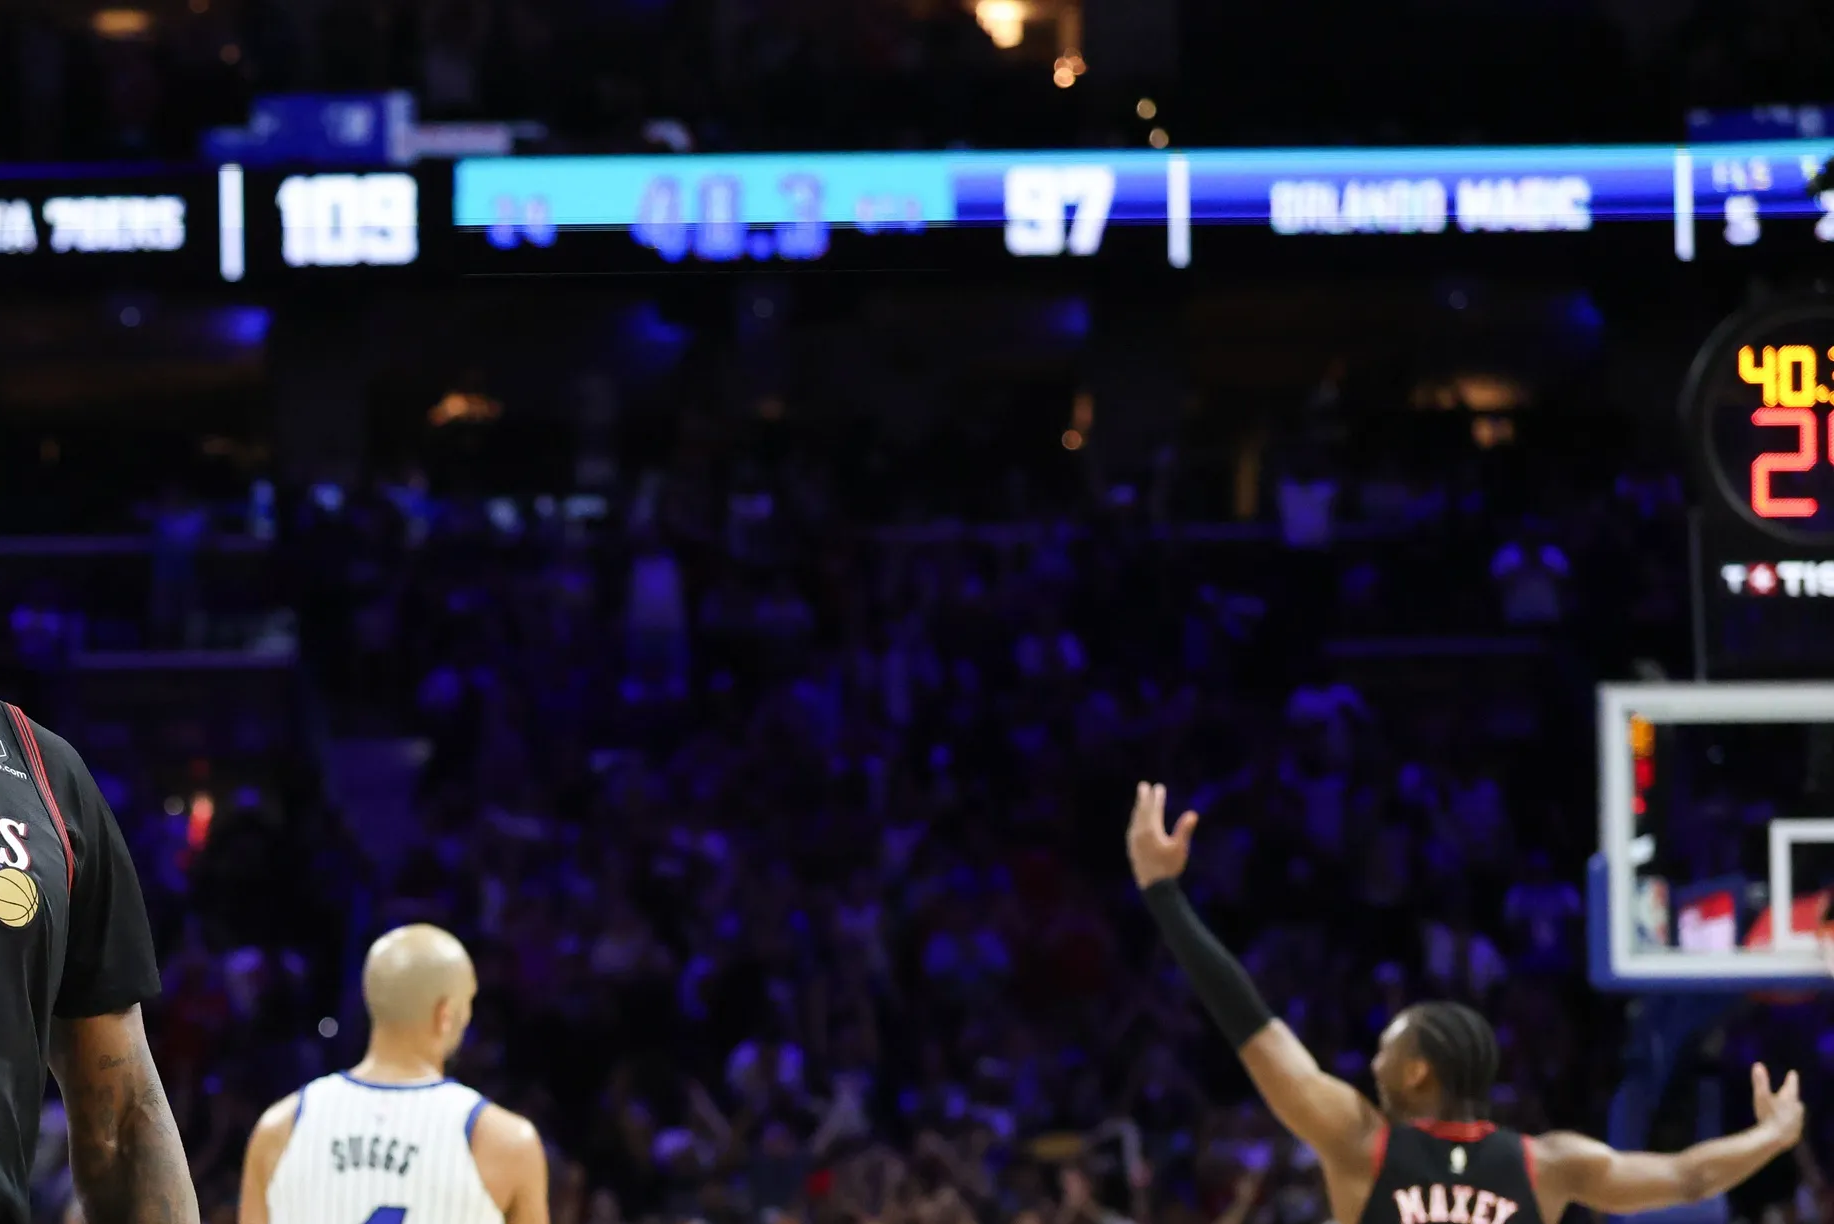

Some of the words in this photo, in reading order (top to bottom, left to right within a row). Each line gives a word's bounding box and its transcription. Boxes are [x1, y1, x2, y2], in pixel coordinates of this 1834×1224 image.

[276, 173, 418, 267] 109
[1003, 164, 1115, 257] 97
[1269, 178, 1447, 235] ORLANDO
[1455, 176, 1593, 232] MAGIC
[1738, 345, 1834, 408] 40.
[1751, 408, 1834, 518] 2
